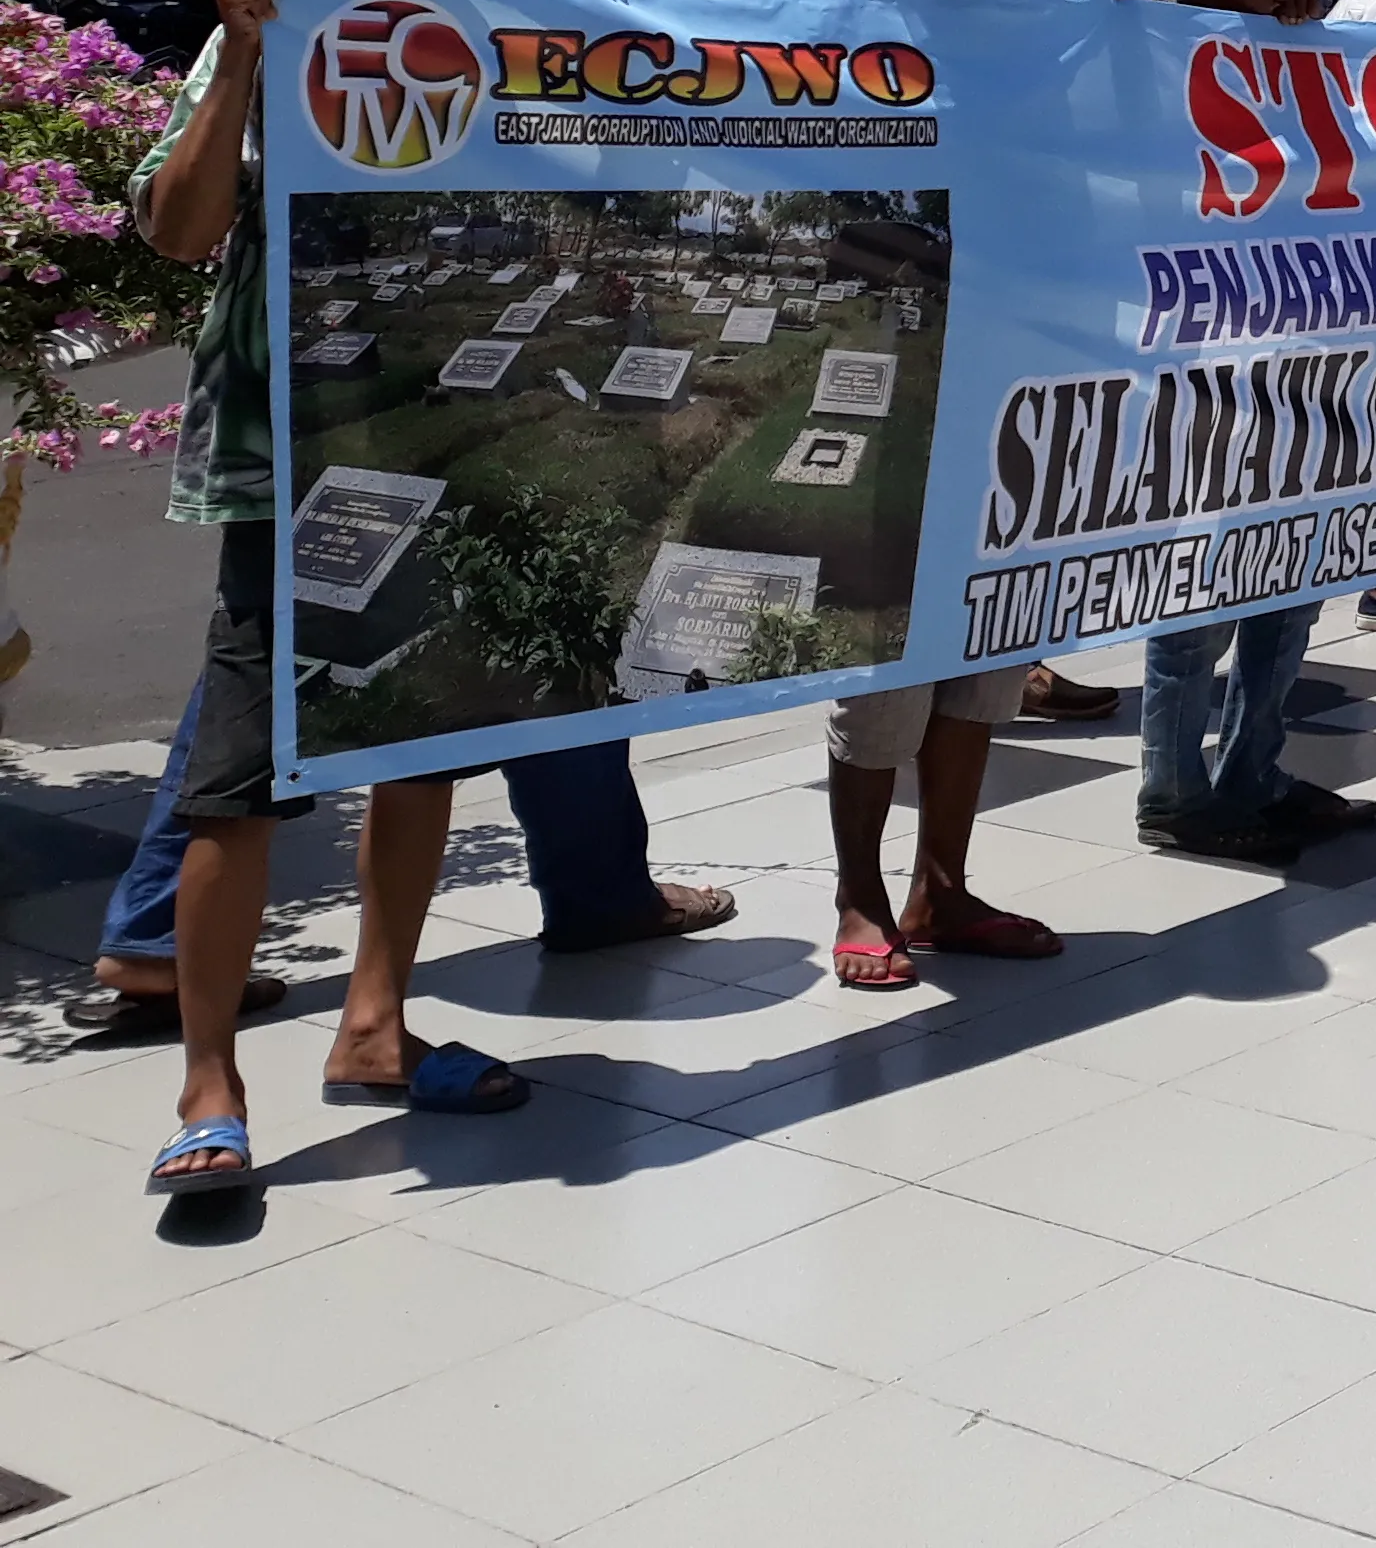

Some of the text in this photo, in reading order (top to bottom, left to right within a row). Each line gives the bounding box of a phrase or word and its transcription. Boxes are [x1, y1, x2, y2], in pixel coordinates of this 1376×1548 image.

[488, 28, 935, 108] ECJWO
[498, 114, 937, 146] EAST JAVA CORRUPTION AND JUDICIAL WATCH ORGANIZATION
[700, 592, 724, 611] SITI
[962, 560, 1051, 662] TIM
[1049, 513, 1318, 646] PENYELAMAT
